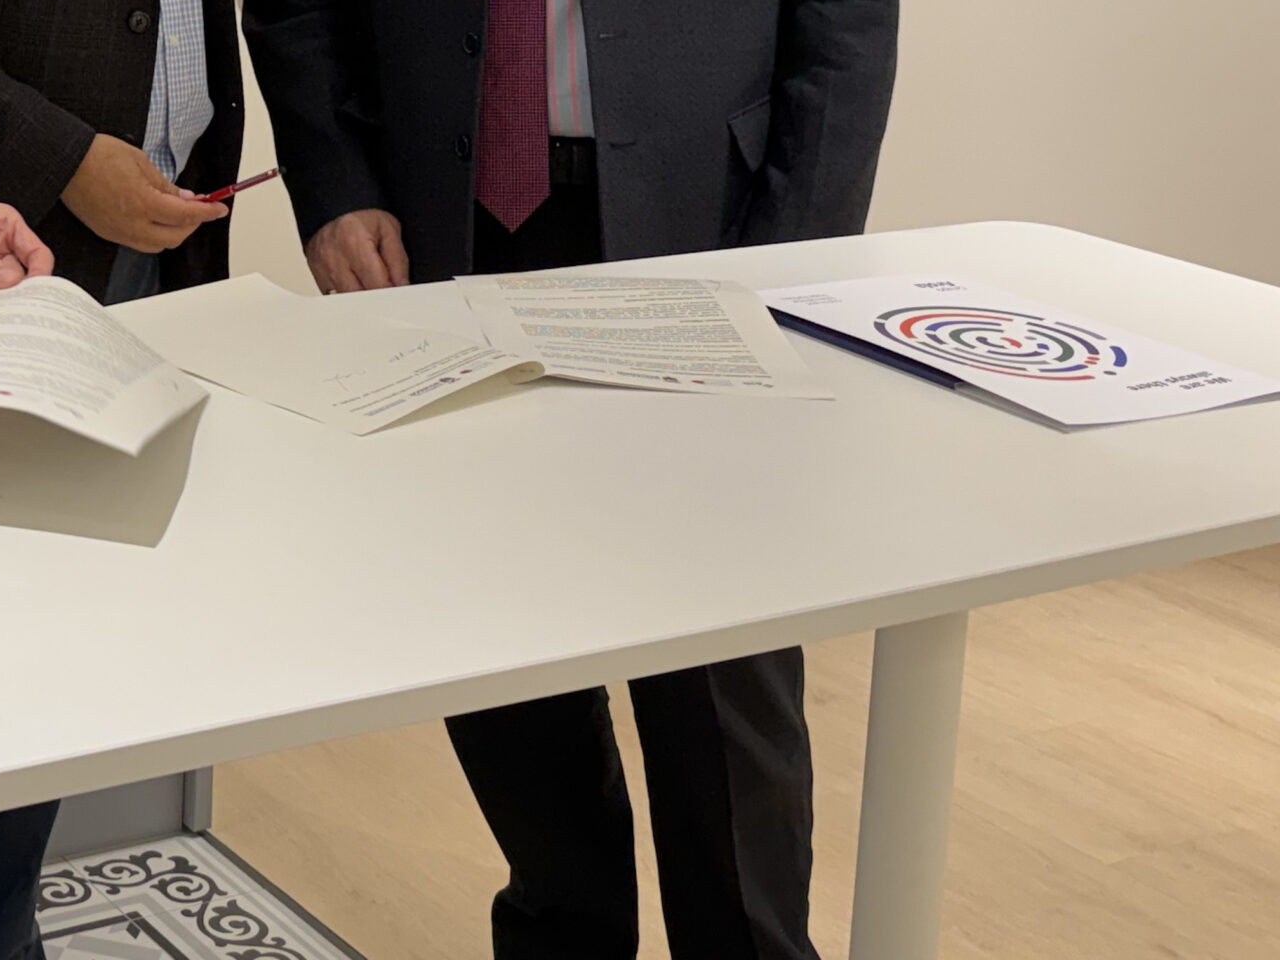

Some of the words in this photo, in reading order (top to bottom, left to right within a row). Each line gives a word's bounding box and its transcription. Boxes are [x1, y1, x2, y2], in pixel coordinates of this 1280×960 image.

[1164, 371, 1213, 383] always
[1203, 376, 1232, 384] We
[1126, 380, 1170, 391] there
[1179, 381, 1206, 390] are
